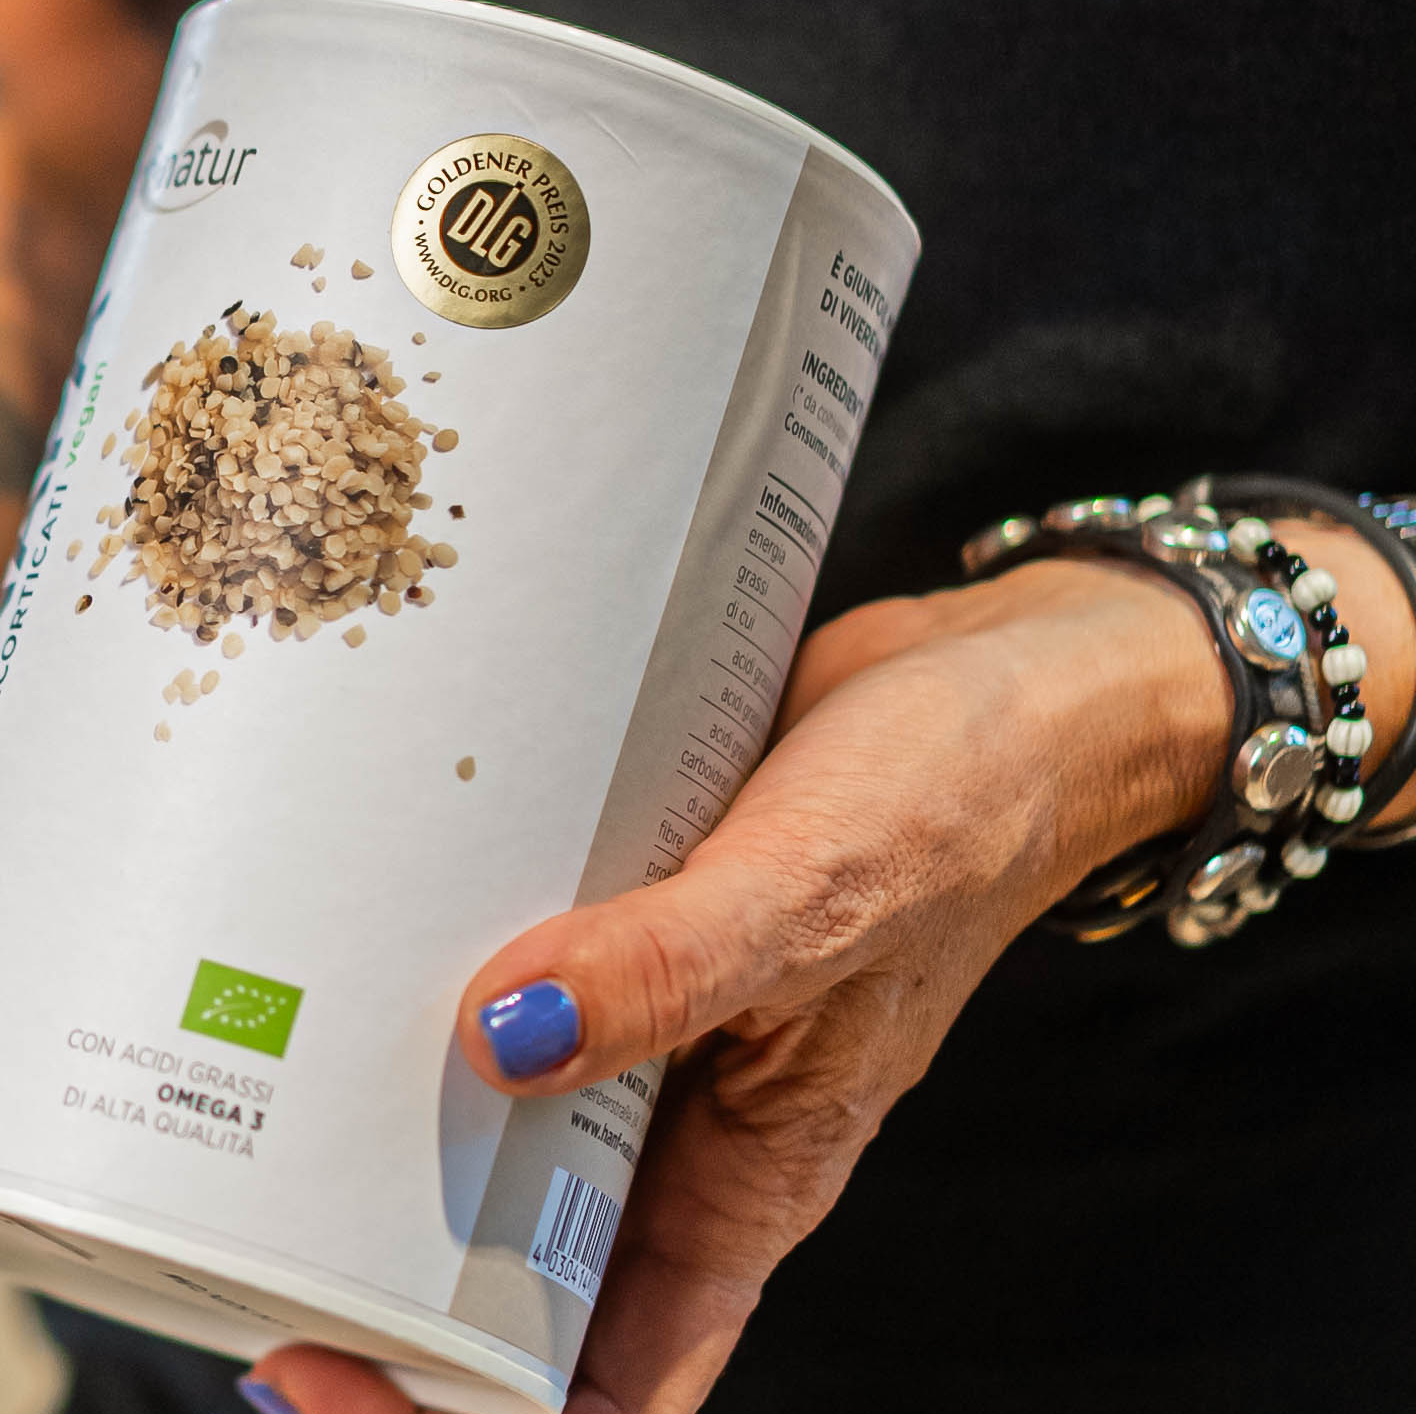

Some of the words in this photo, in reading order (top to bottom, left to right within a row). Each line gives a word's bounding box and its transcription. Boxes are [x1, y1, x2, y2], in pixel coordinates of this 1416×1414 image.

[417, 151, 533, 212] GOLDENER
[531, 172, 570, 235] PREIS
[446, 181, 534, 269] DLG
[528, 239, 567, 289] 2023
[830, 249, 845, 280] È
[820, 288, 839, 318] DI
[801, 349, 865, 421] INGREDIENT
[65, 362, 108, 469] vegan
[784, 412, 829, 460] Consumo
[748, 527, 787, 566] energia
[736, 563, 770, 596] grassi
[726, 600, 739, 620] di
[738, 609, 756, 631] cui
[657, 819, 685, 851] fibre
[66, 1028, 116, 1057] CON
[118, 1042, 184, 1076] ACIDI
[187, 1060, 275, 1105] GRASSI
[62, 1085, 87, 1109] DI
[89, 1094, 147, 1127] ALTA
[156, 1082, 242, 1126] OMEGA
[249, 1109, 266, 1131] 3
[532, 1243, 543, 1266] 4
